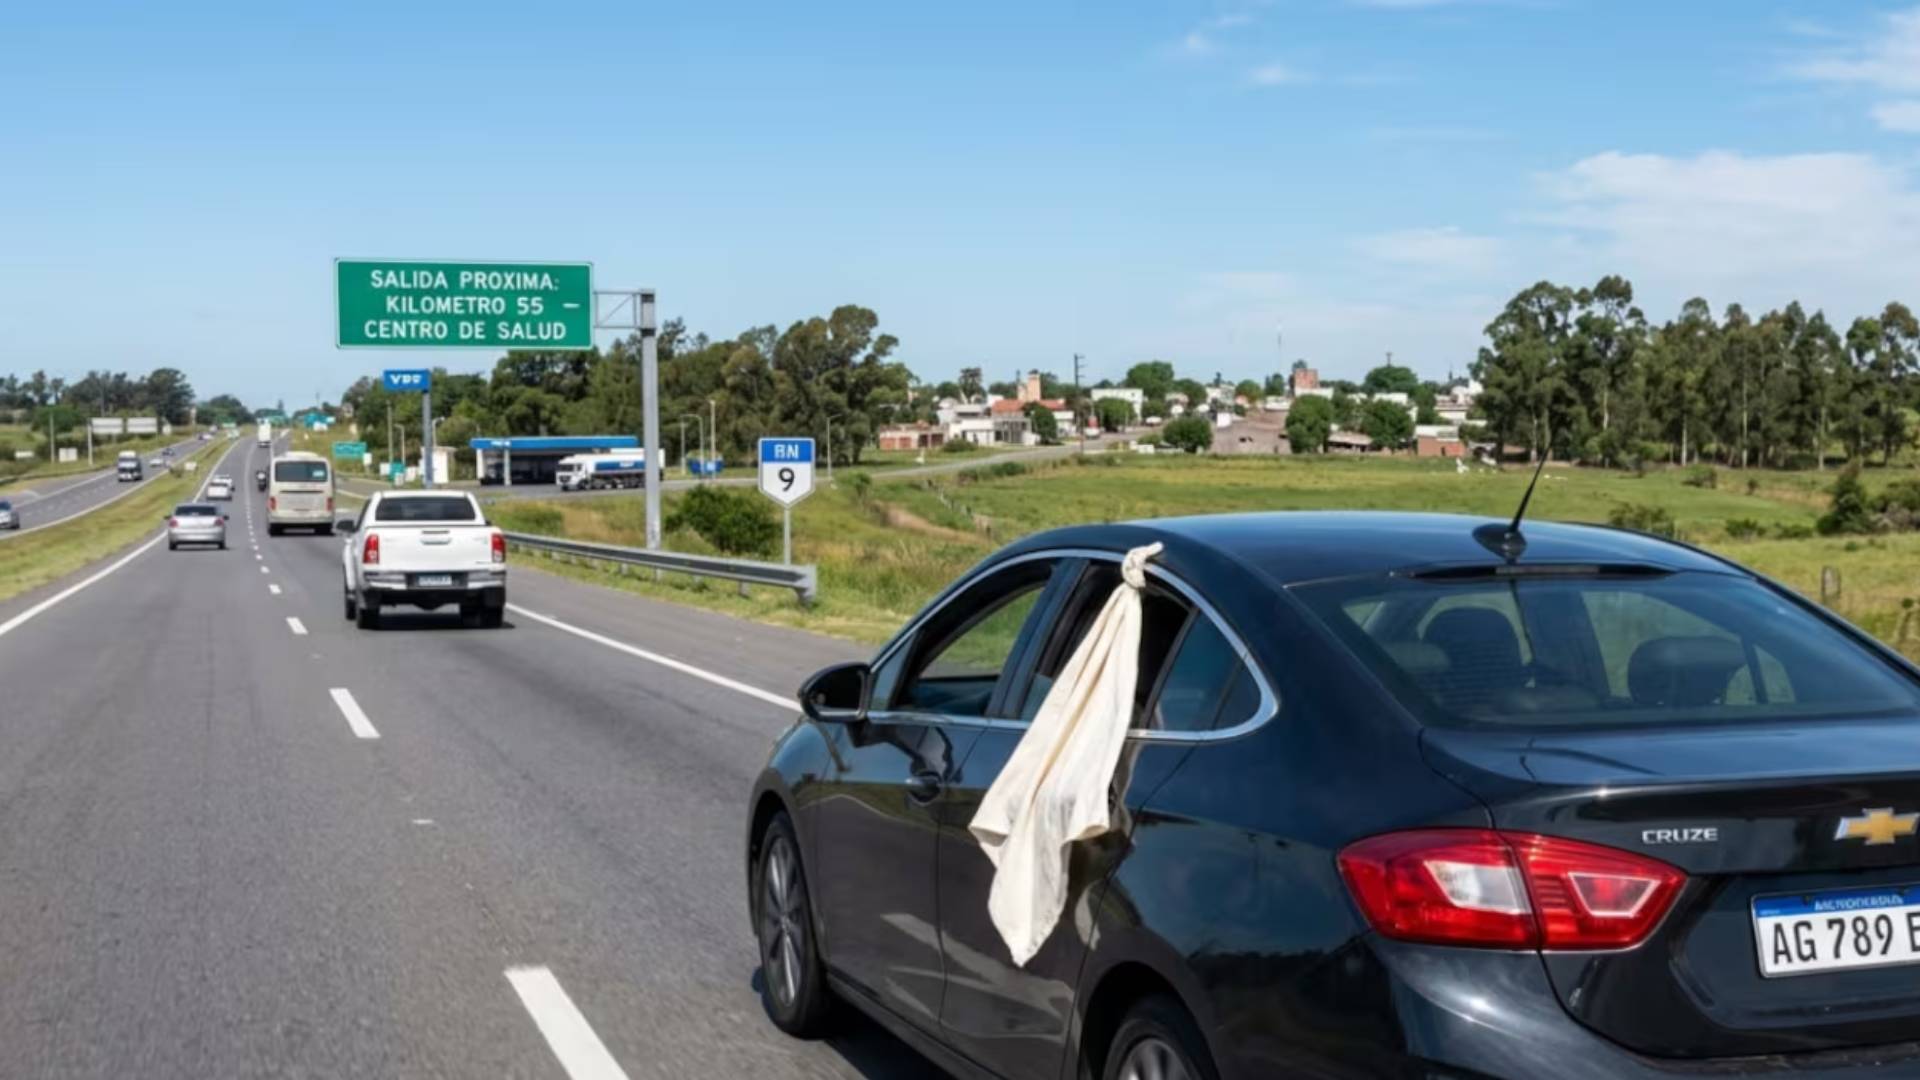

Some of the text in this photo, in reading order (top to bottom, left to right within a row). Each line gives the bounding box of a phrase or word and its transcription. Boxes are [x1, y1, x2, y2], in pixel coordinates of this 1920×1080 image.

[371, 270, 559, 291] SALIDA PROXIMA:
[386, 296, 506, 315] KILOMETRO
[517, 297, 544, 315] 55
[364, 320, 566, 340] CENTRO DE SALUD
[774, 444, 799, 459] RN
[779, 467, 795, 491] 9
[1642, 827, 1718, 844] CRUZE
[1773, 920, 1817, 965] AG
[1827, 913, 1893, 960] 789
